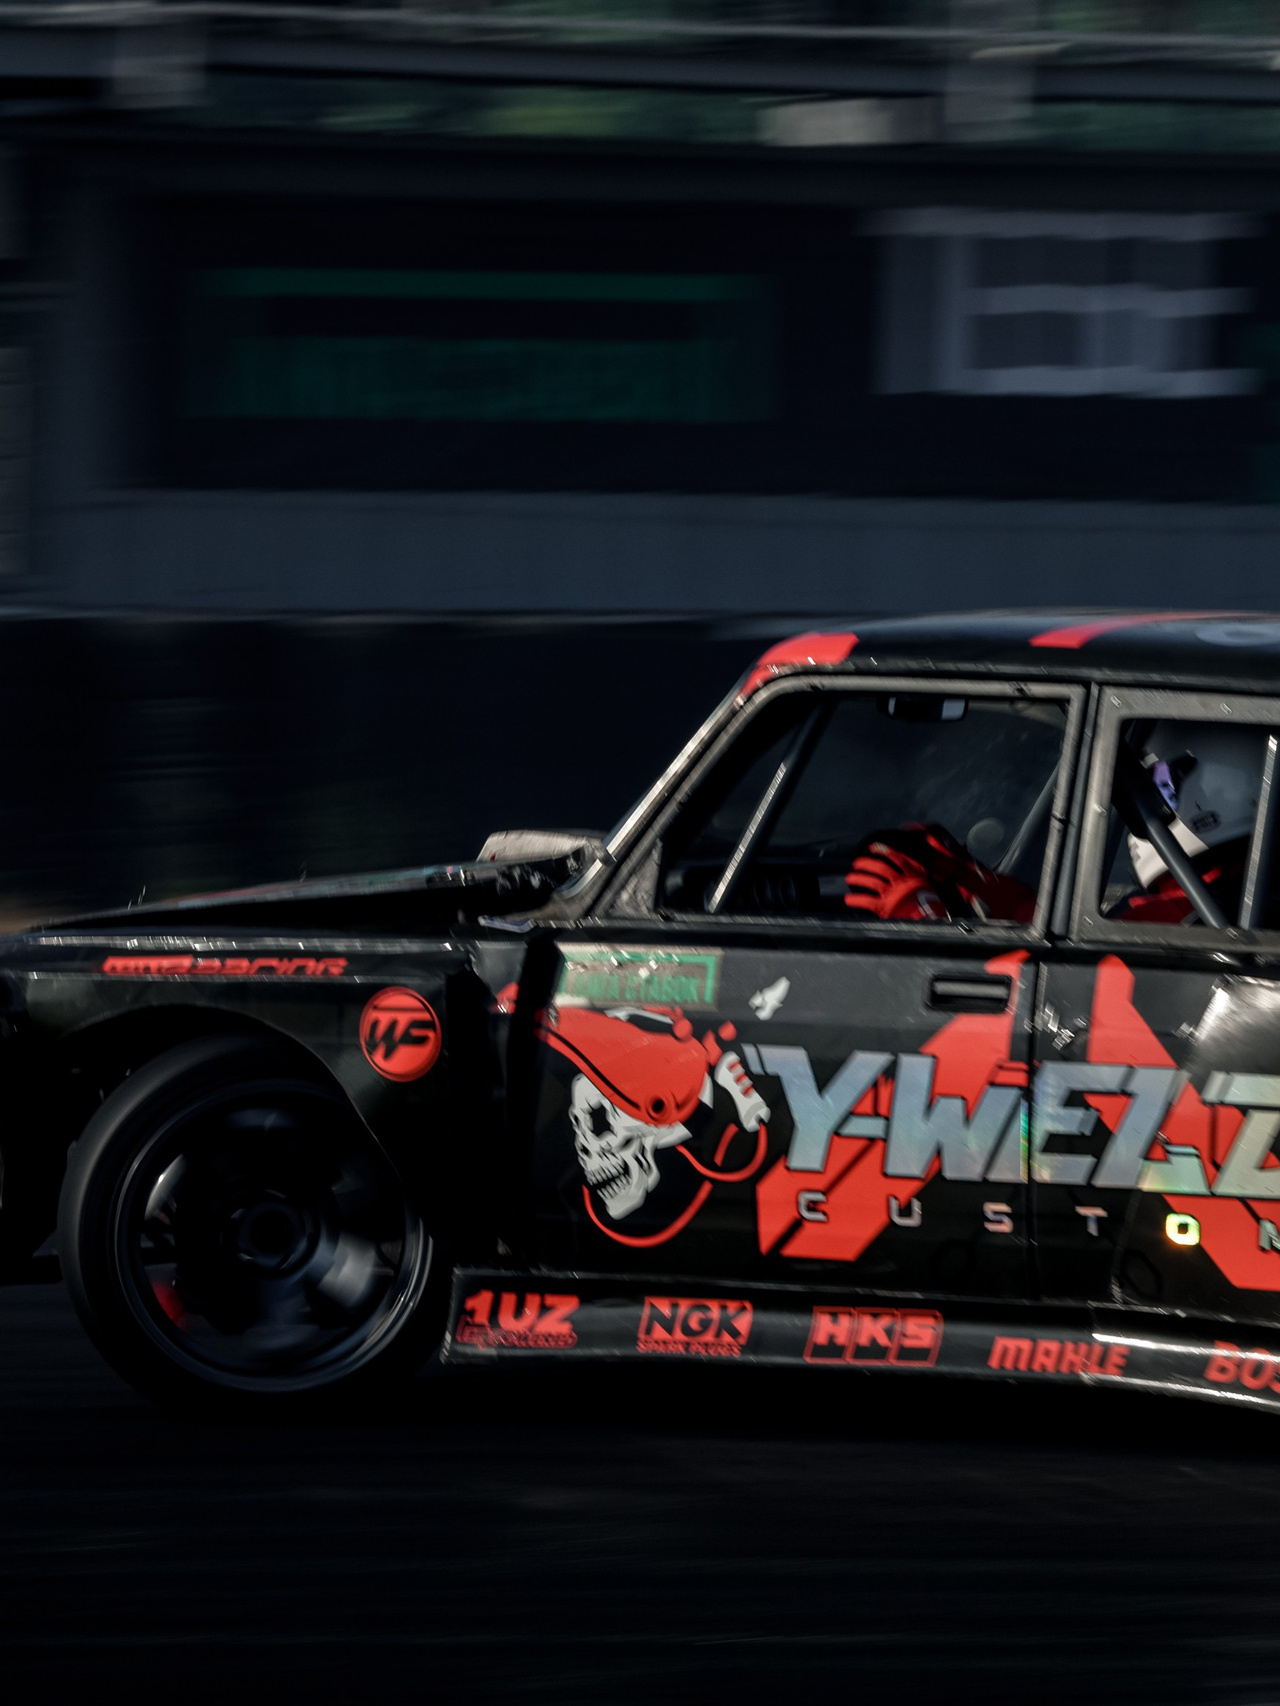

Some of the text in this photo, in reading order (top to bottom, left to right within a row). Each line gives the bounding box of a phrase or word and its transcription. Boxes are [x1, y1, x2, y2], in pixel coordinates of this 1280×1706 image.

[463, 1288, 580, 1336] 1UZ
[644, 1301, 748, 1339] NGK
[812, 1312, 938, 1349] HKS
[987, 1336, 1131, 1376] MAHLE
